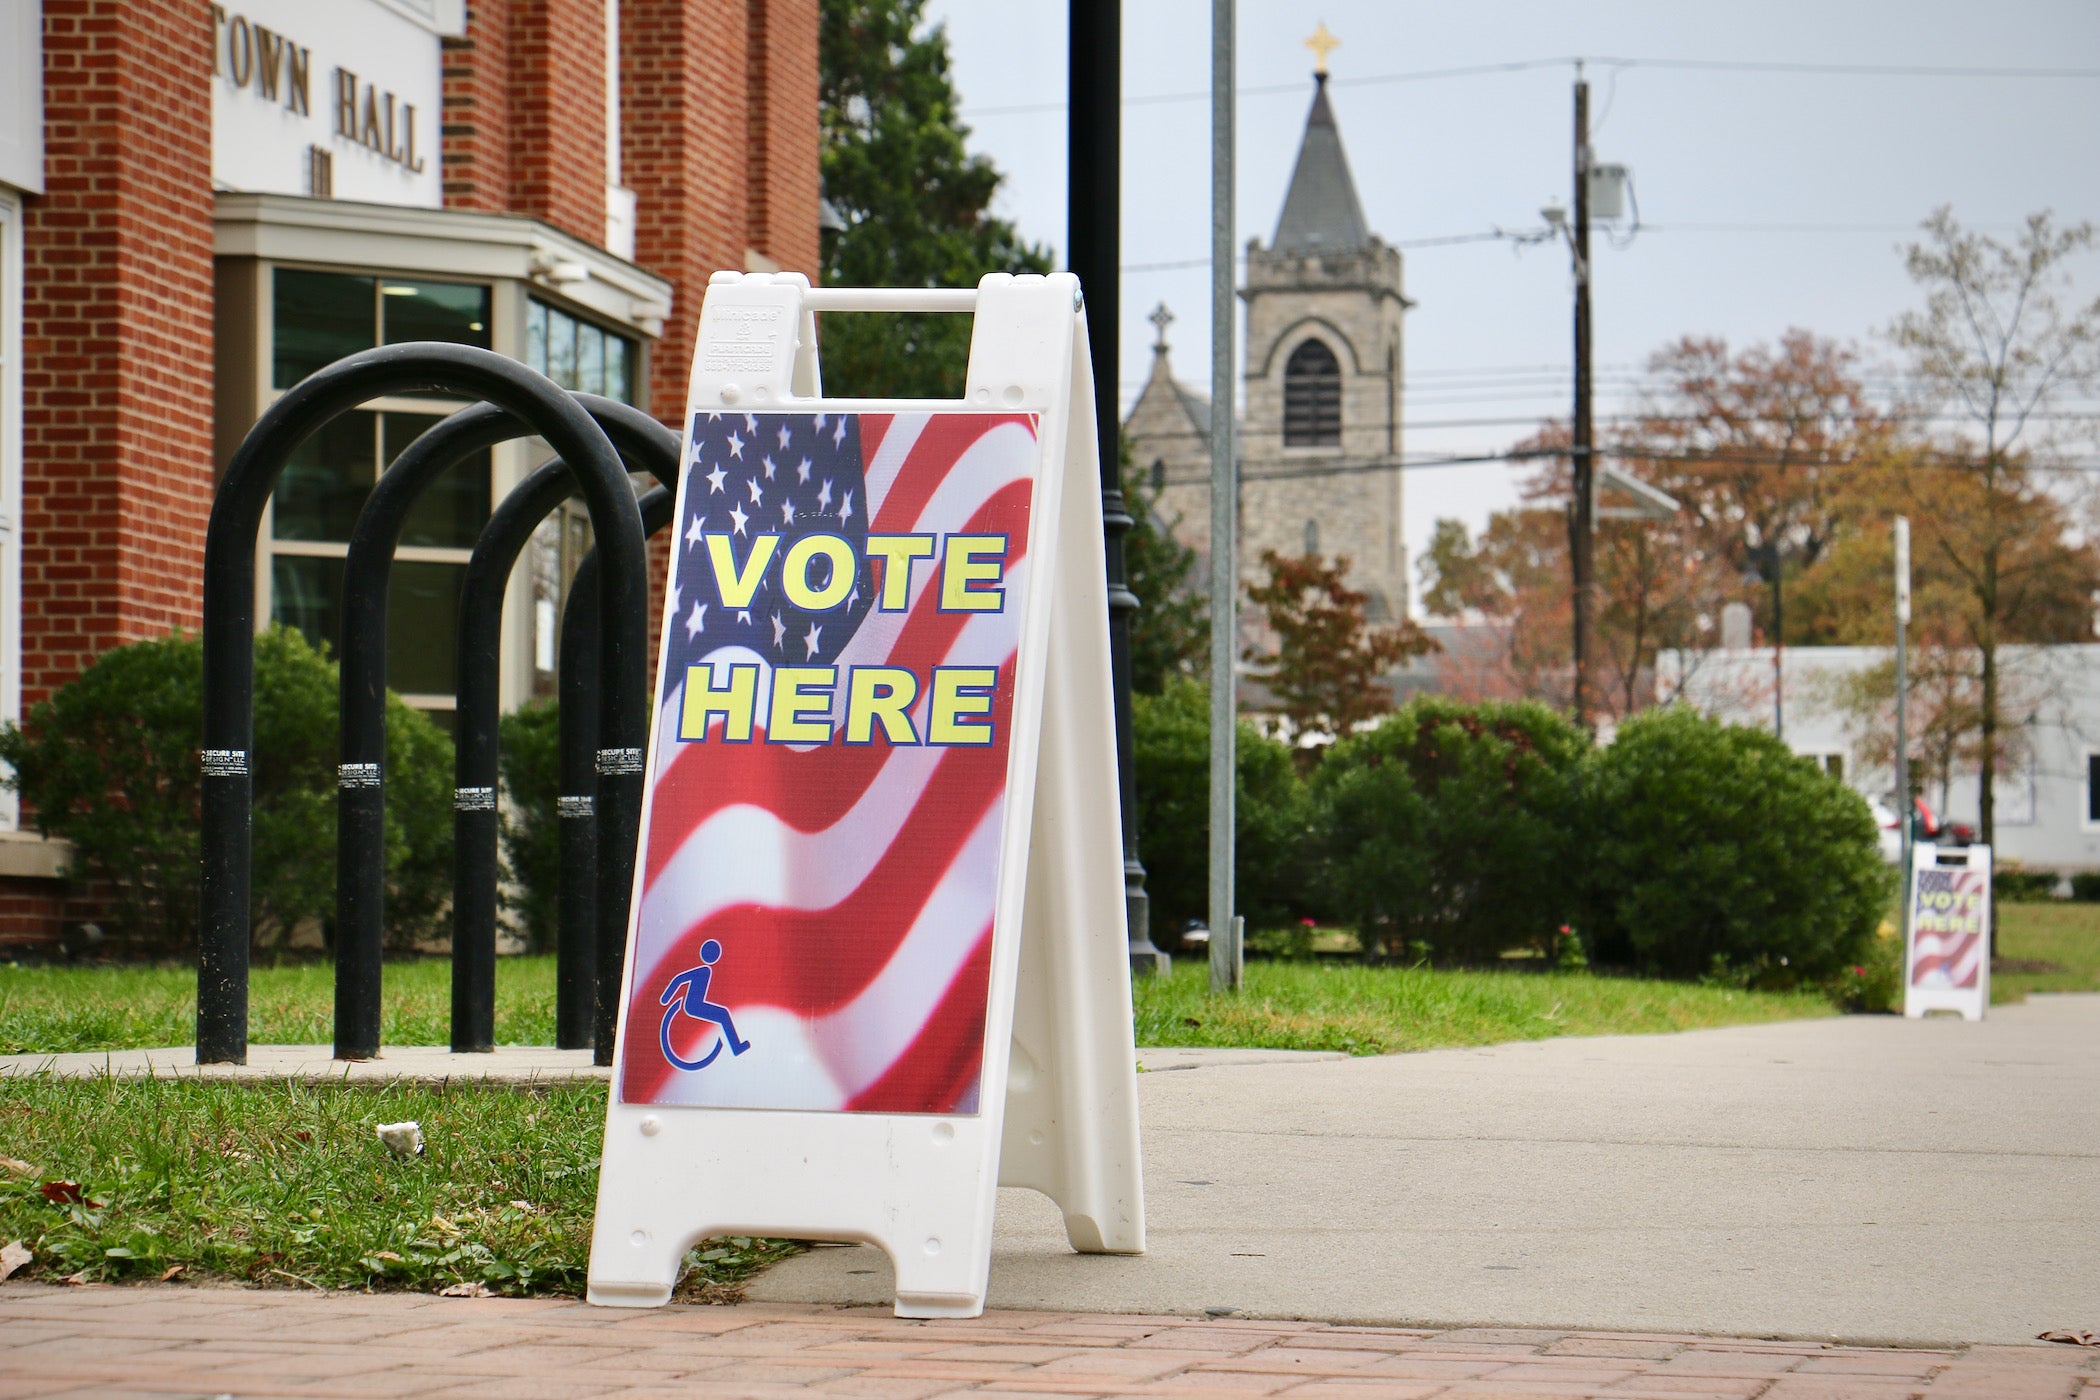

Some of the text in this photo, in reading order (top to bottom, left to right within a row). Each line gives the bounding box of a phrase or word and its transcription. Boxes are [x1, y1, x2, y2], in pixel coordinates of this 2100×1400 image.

[211, 3, 310, 118] TOWN
[335, 66, 424, 174] HALL
[705, 532, 1008, 614] VOTE
[676, 663, 998, 747] HERE
[1917, 915, 1979, 932] HERE
[1920, 891, 1979, 909] VOTE
